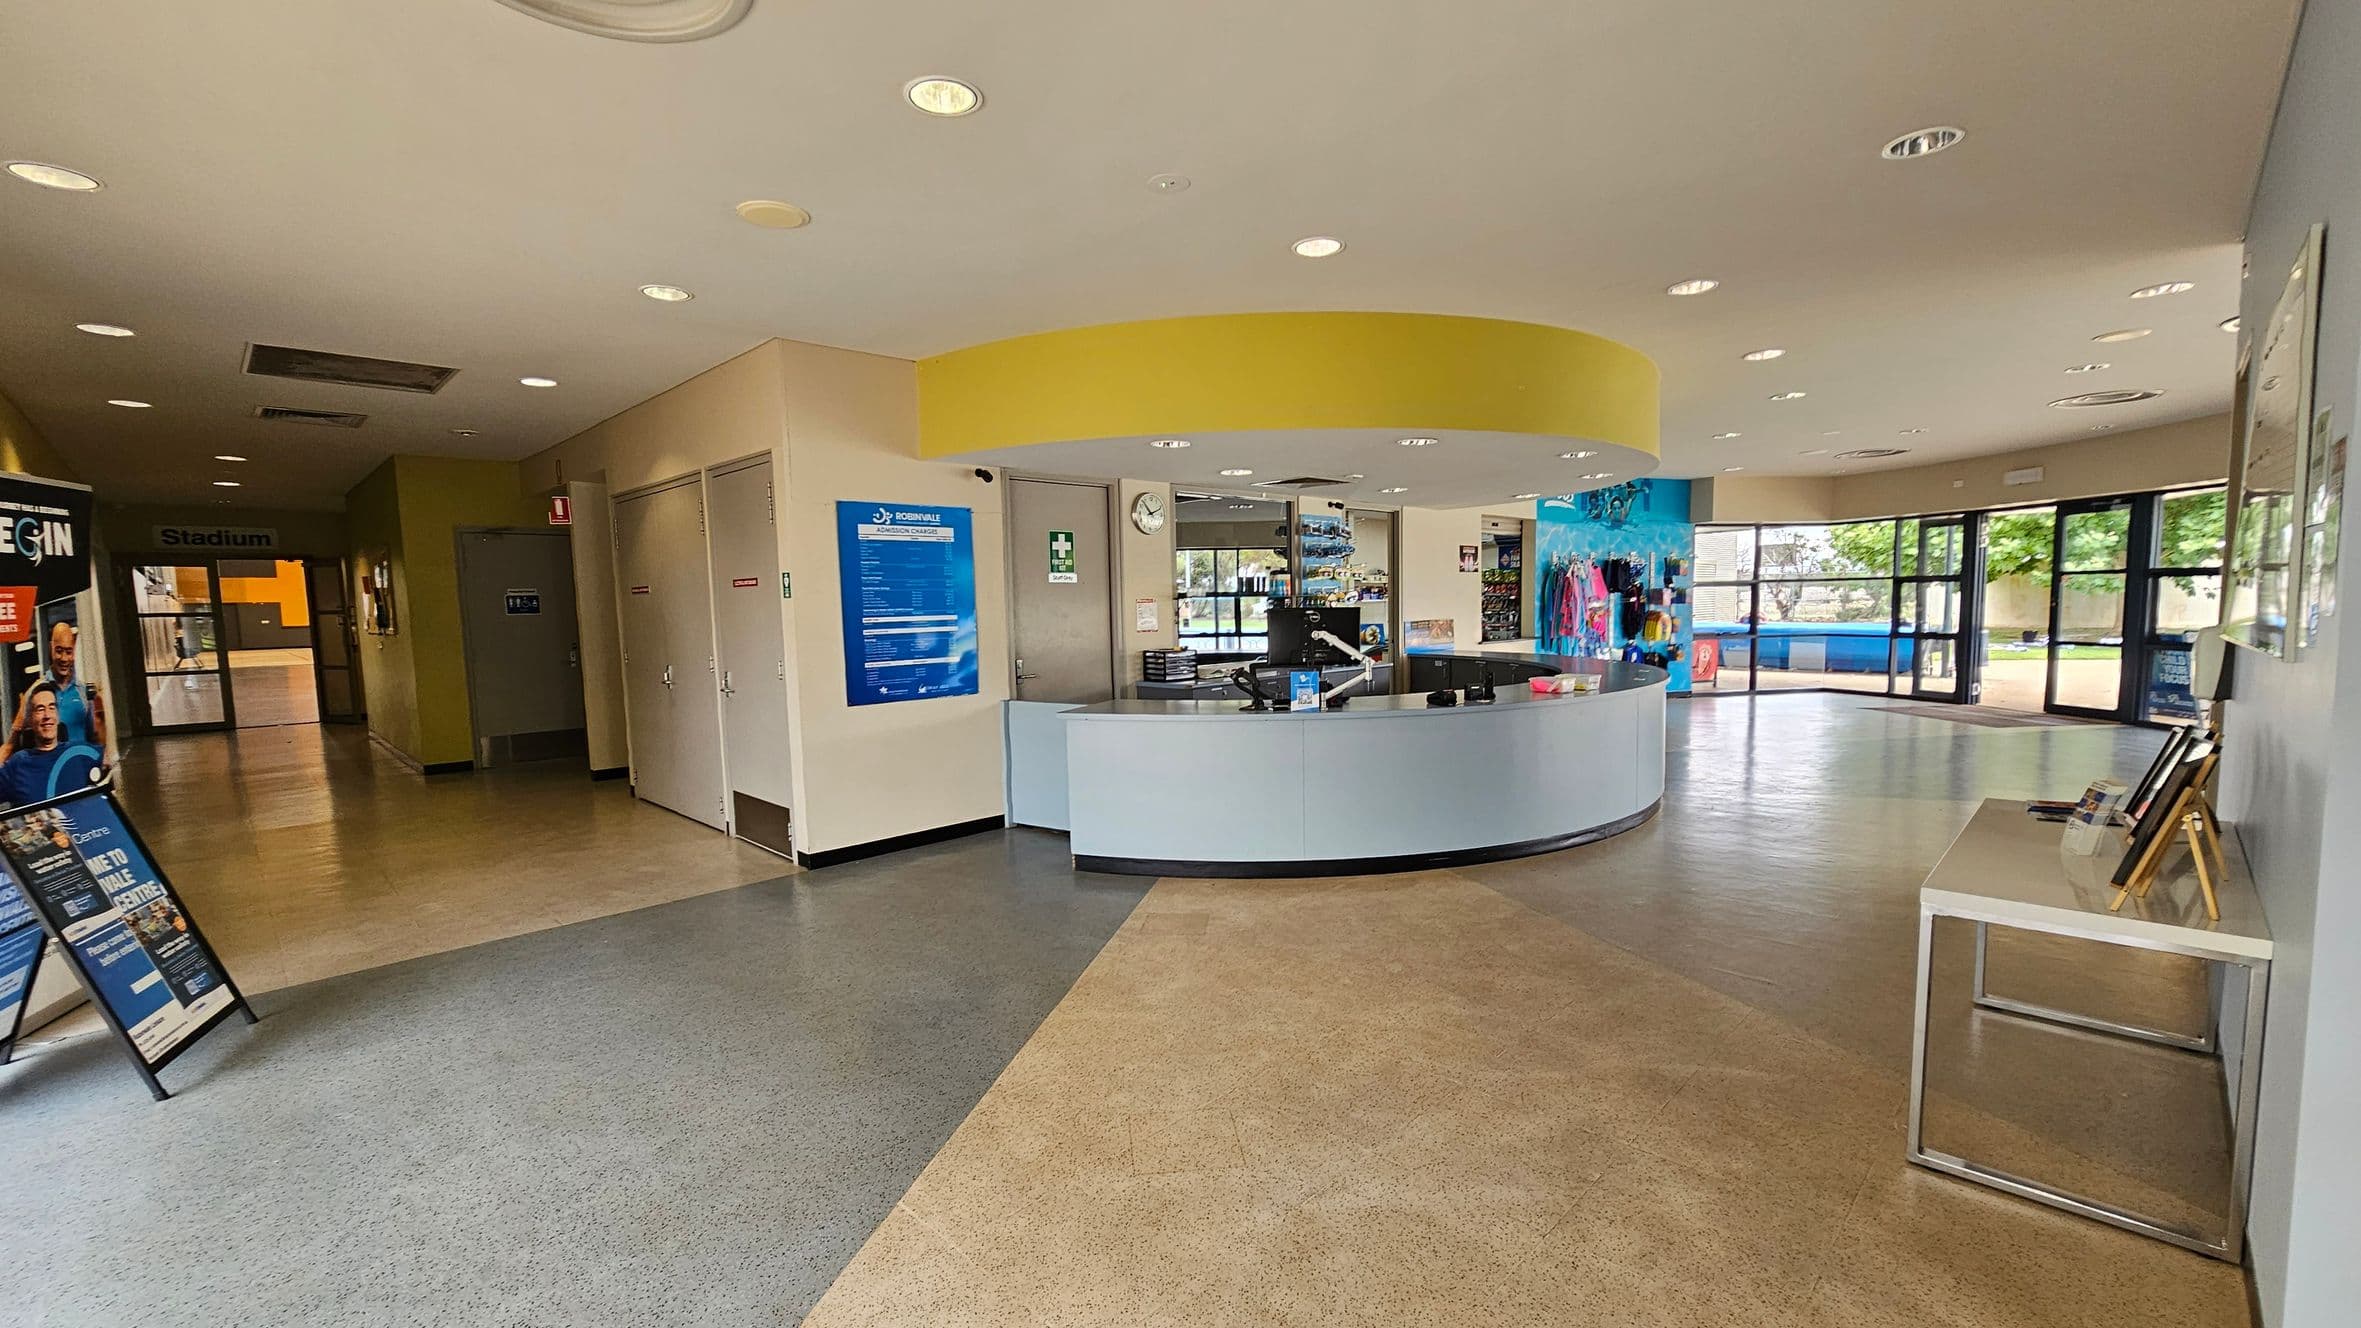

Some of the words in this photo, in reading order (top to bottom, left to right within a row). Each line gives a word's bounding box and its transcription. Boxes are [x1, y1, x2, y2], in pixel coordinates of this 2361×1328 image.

[895, 512, 941, 522] ROBINVALE
[161, 528, 272, 546] Stadium
[2160, 673, 2190, 685] FOCUS
[72, 826, 111, 845] Centre
[106, 848, 129, 867] TO
[112, 880, 161, 912] CENTRE
